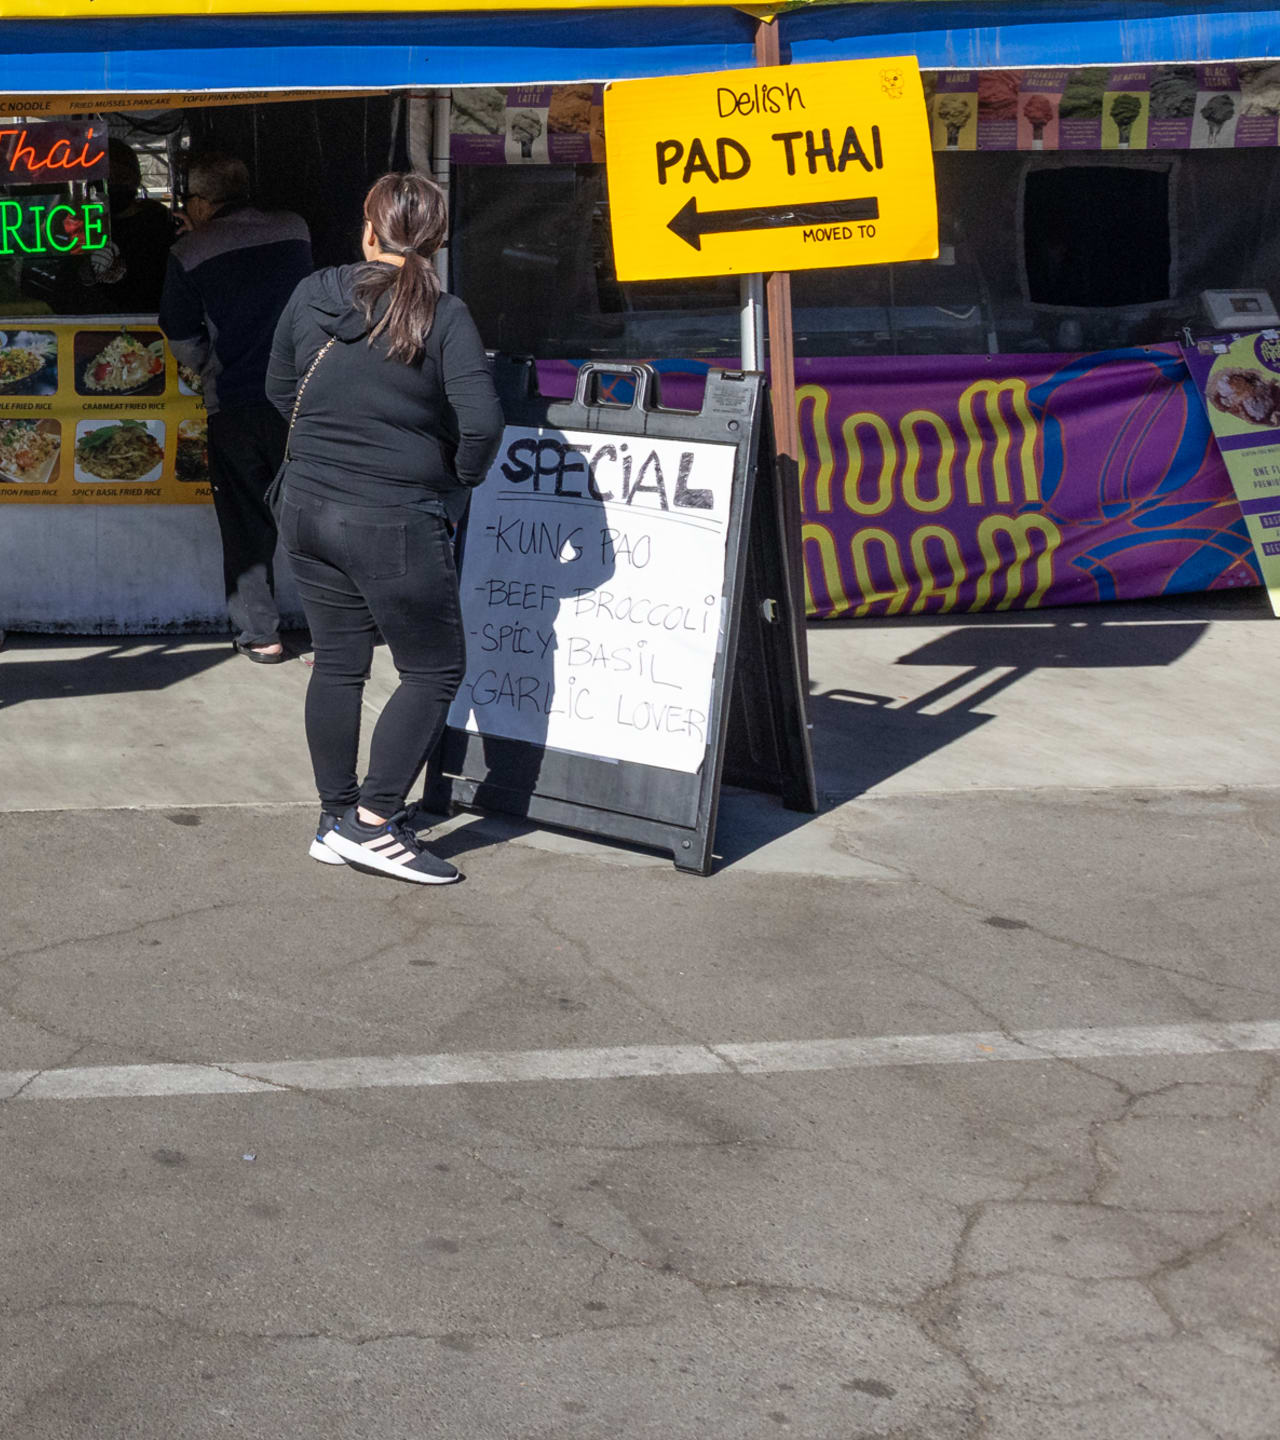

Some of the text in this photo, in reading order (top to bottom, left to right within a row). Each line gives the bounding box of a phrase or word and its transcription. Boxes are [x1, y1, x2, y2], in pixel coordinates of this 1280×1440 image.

[9, 101, 51, 111] NOODLE
[70, 97, 171, 109] FRIED MUSSELS PANCAKE
[183, 94, 207, 103] TOFU
[208, 93, 229, 102] PINK
[717, 82, 806, 118] Delish
[655, 125, 883, 185] PAD THAI
[803, 224, 876, 243] MOVED TO
[600, 527, 651, 569] PAO
[617, 694, 706, 743] LOVER
